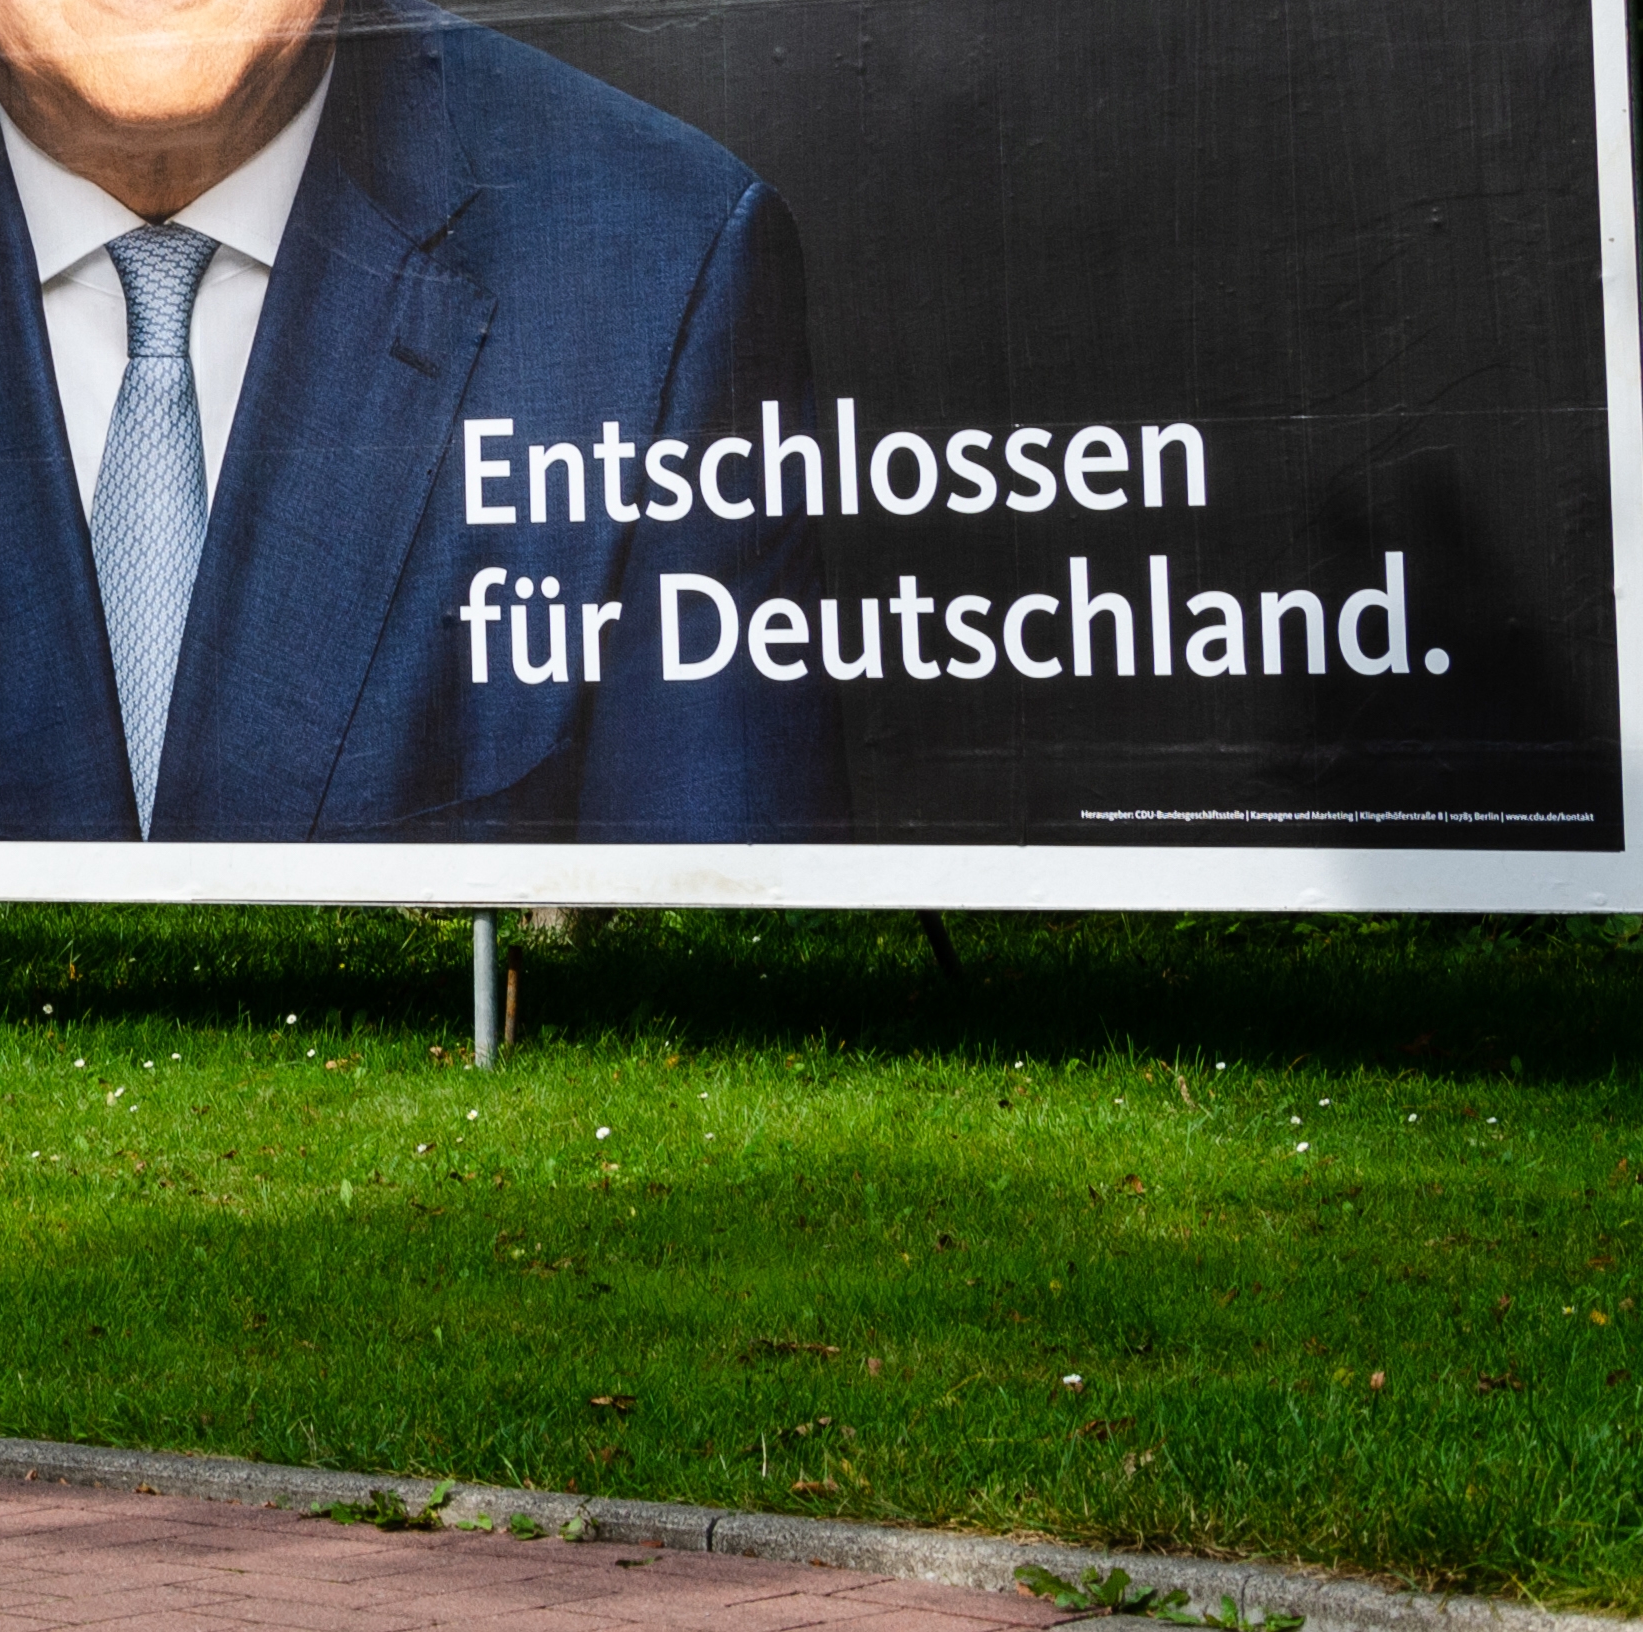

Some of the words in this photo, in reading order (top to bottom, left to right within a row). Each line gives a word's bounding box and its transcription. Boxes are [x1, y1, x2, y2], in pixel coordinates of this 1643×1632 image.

[463, 397, 1206, 525] Entschlossen
[459, 567, 623, 685] für
[659, 551, 1450, 682] Deutschland.
[1294, 811, 1310, 820] und
[1474, 812, 1500, 821] Berlin
[1505, 812, 1595, 822] www.cdu.de/kontakt
